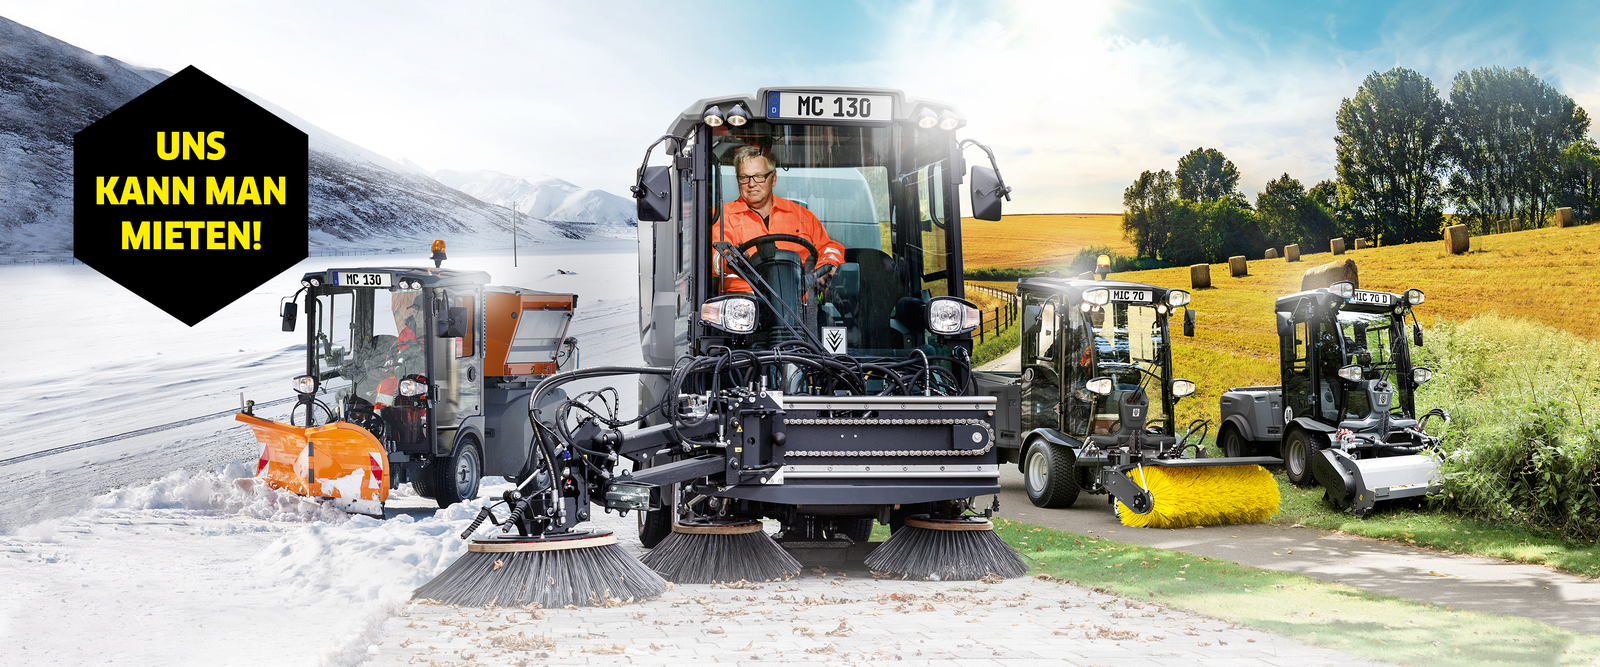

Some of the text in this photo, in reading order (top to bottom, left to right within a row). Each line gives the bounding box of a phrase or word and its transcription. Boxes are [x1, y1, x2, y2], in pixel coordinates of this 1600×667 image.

[771, 106, 777, 114] D
[797, 95, 871, 118] MC 130
[346, 273, 360, 285] MC
[363, 274, 382, 286] 130
[1113, 290, 1145, 301] MIC 70
[1353, 292, 1388, 304] MIC 70 D
